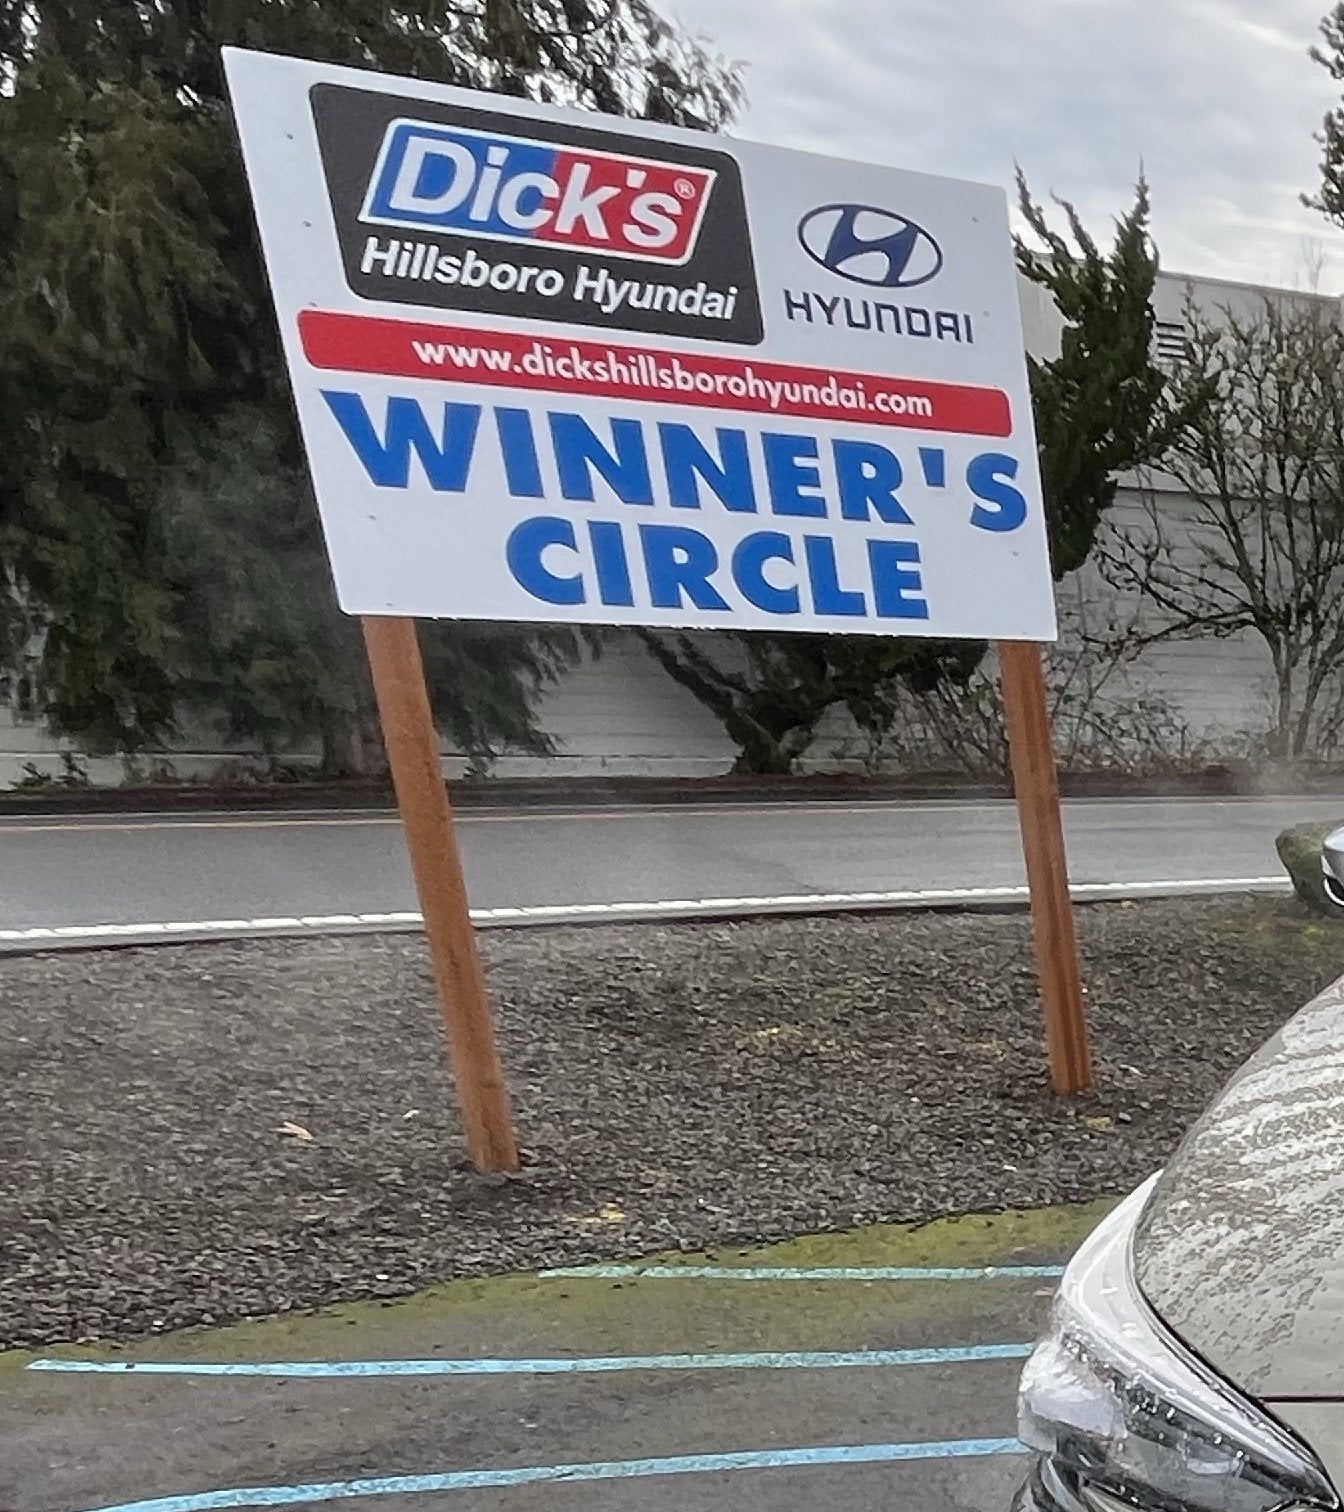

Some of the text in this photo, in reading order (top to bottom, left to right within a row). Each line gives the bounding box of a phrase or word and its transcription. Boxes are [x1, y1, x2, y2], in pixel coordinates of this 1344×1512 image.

[360, 237, 738, 321] Hillsboro Hyundai
[785, 290, 973, 344] HYUNDAI
[413, 337, 933, 419] www.dickshillsborohyundai.com
[320, 390, 1027, 533] WINNER'S
[505, 516, 930, 620] CIRCLE
